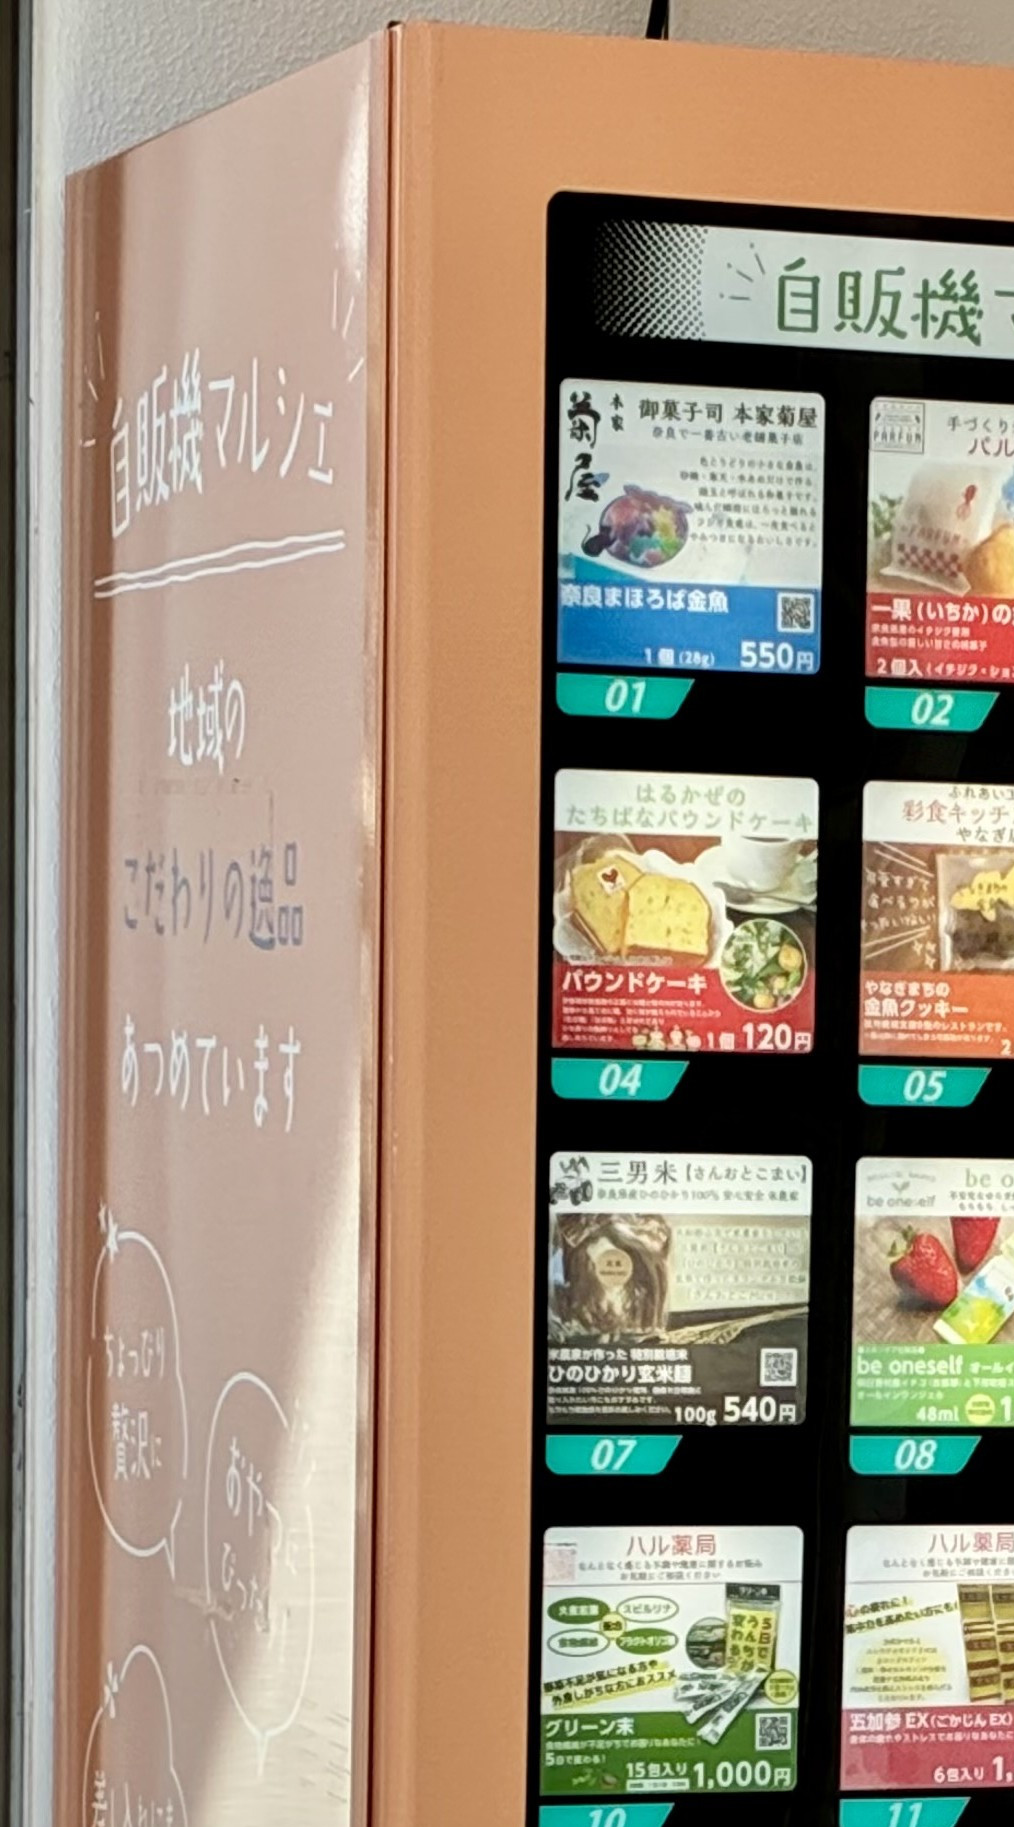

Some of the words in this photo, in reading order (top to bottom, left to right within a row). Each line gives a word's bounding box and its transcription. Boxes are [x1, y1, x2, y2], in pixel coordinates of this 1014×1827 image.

[640, 398, 723, 422] 御菓子司
[734, 402, 817, 428] 本家菊屋
[110, 347, 333, 538] 自販機マルシェ
[561, 584, 728, 613] 奈良まほろば金魚
[605, 679, 646, 713] 01
[167, 658, 246, 775] 地域の
[912, 694, 954, 726] 02
[637, 784, 746, 806] はるかぜの
[567, 805, 812, 832] たちばなパウンドケーキ
[123, 842, 304, 950] こだわりの逸品
[562, 971, 708, 994] パウンドケーキ
[865, 981, 950, 998] やなぎまちの
[864, 999, 969, 1018] 金魚クッキー
[121, 1014, 301, 1133] あつめています
[599, 1064, 642, 1096] 04
[903, 1070, 948, 1101] 05
[965, 1168, 992, 1188] be
[867, 1196, 885, 1208] be
[549, 1365, 692, 1384] ひのひかり玄米麺
[857, 1356, 884, 1375] be
[889, 1355, 964, 1376] oneself
[674, 1405, 717, 1426] 100g
[916, 1406, 960, 1422] 48ml
[112, 1402, 163, 1481] 贅沢に
[591, 1438, 637, 1471] 07
[895, 1439, 938, 1471] 08
[627, 1534, 717, 1558] ハル薬局
[545, 1718, 635, 1738] グリーン末
[626, 1762, 688, 1778] 15包入り
[933, 1766, 984, 1784] 6包入り
